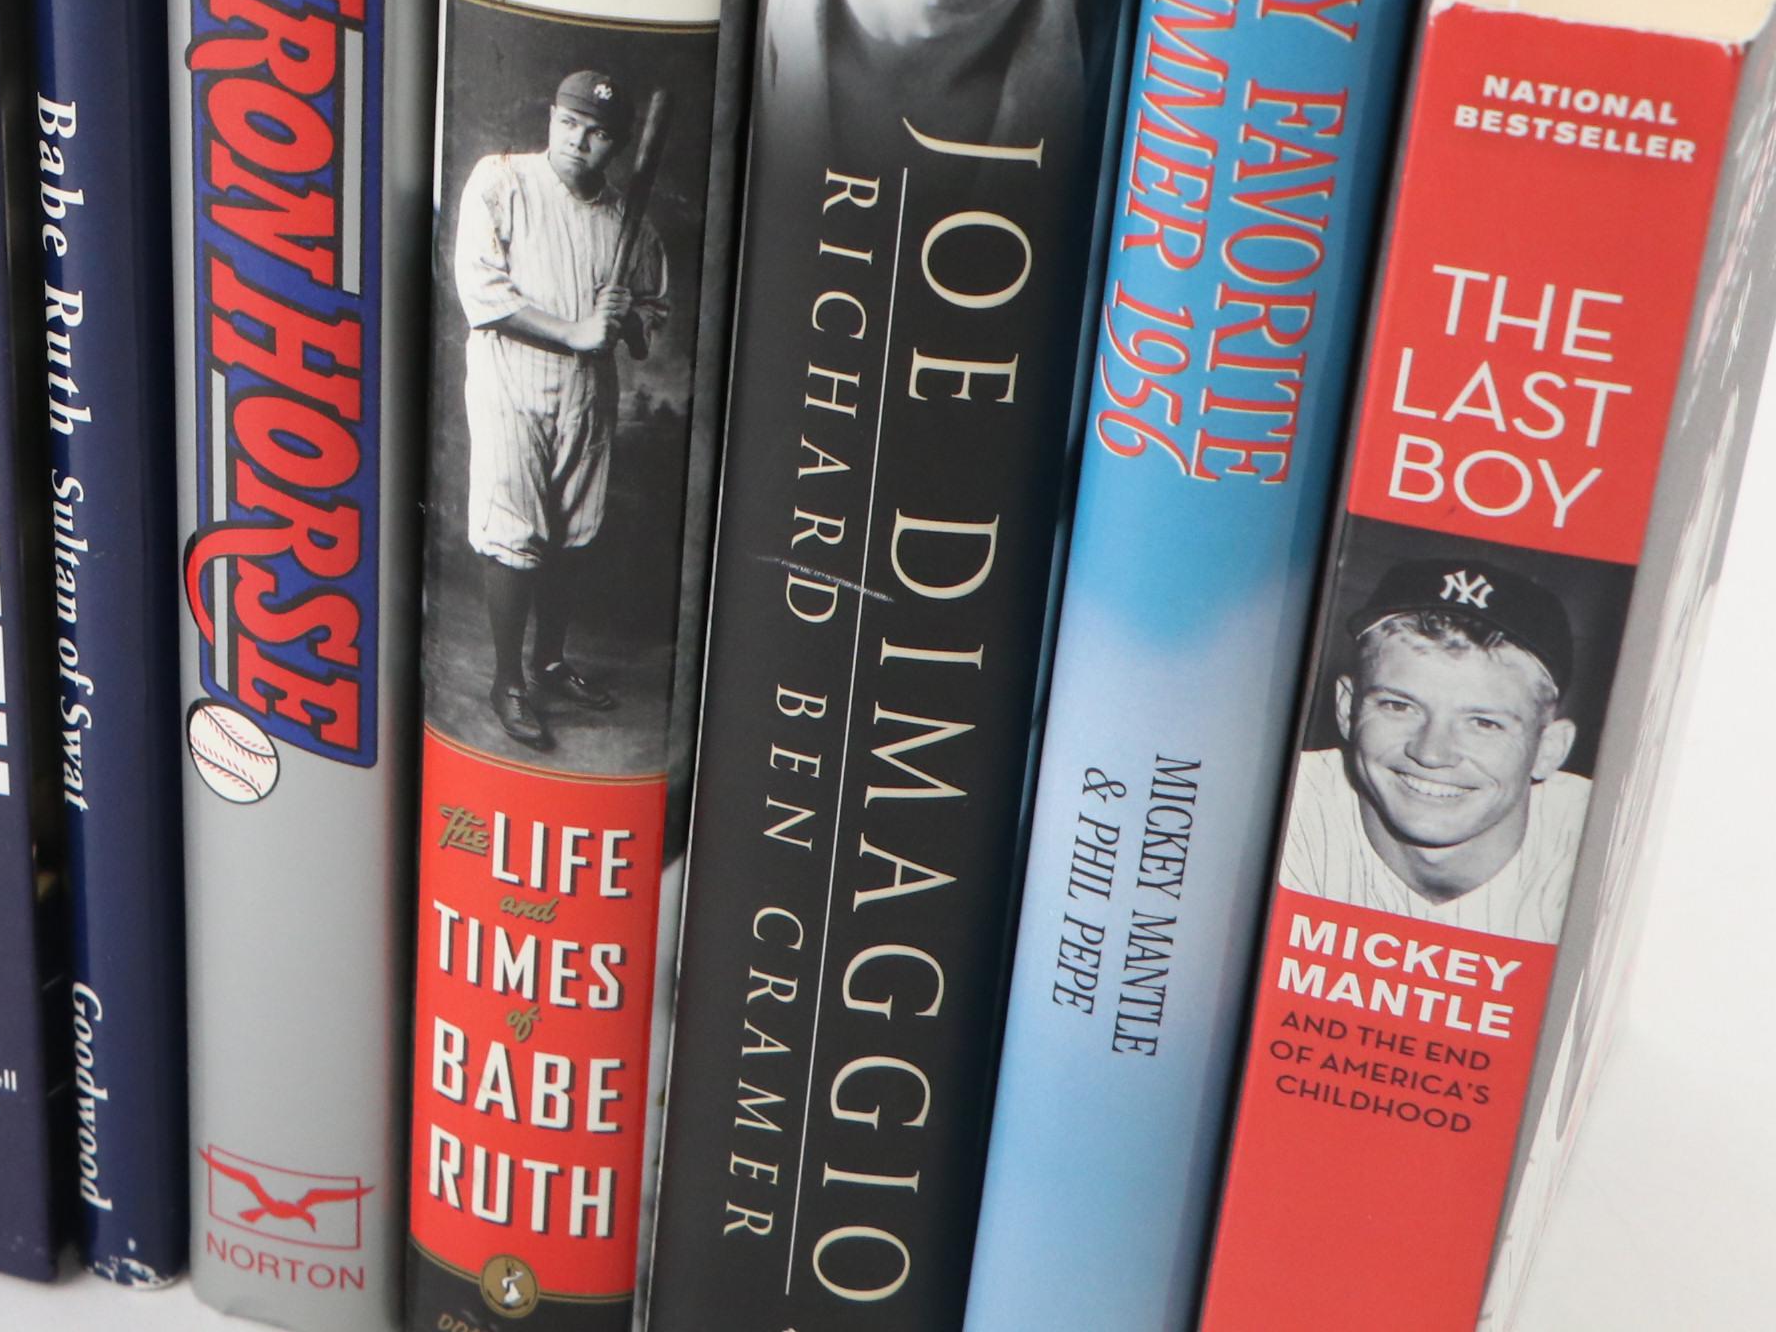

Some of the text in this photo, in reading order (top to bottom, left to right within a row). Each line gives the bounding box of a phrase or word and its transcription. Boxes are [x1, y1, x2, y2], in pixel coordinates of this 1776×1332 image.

[1454, 104, 1696, 164] BESTSELLER
[1482, 74, 1678, 125] NATIONAL
[1191, 78, 1350, 487] FAVORITE
[1433, 264, 1623, 362] THE
[1095, 279, 1192, 477] 1956
[1391, 347, 1632, 448] LAST
[36, 91, 94, 813] Babe Ruth Sultan of Swat
[1388, 432, 1603, 528] BOY
[184, 254, 366, 751] HORSE
[722, 168, 881, 1238] RICHARD BEN CRAMER
[812, 116, 1044, 1302] JOE DIMAGGIO
[491, 810, 632, 899] LIFE
[1052, 766, 1128, 1015] & PHIL PEPE
[432, 898, 624, 1011] TIMES
[498, 894, 557, 924] and
[1111, 753, 1202, 1057] MICKEY MANTLE
[1288, 913, 1523, 993] MICKEY
[505, 1007, 540, 1042] of
[1277, 956, 1515, 1039] MANTLE
[1280, 1010, 1491, 1072] AND THE END
[72, 981, 113, 1212] Goodwood
[431, 1015, 622, 1133] BABE
[1269, 1039, 1491, 1105] OF AMERICA'S
[1275, 1074, 1473, 1134] CHILDHOOD
[427, 1122, 616, 1239] RUTH
[206, 1231, 365, 1291] NORTON
